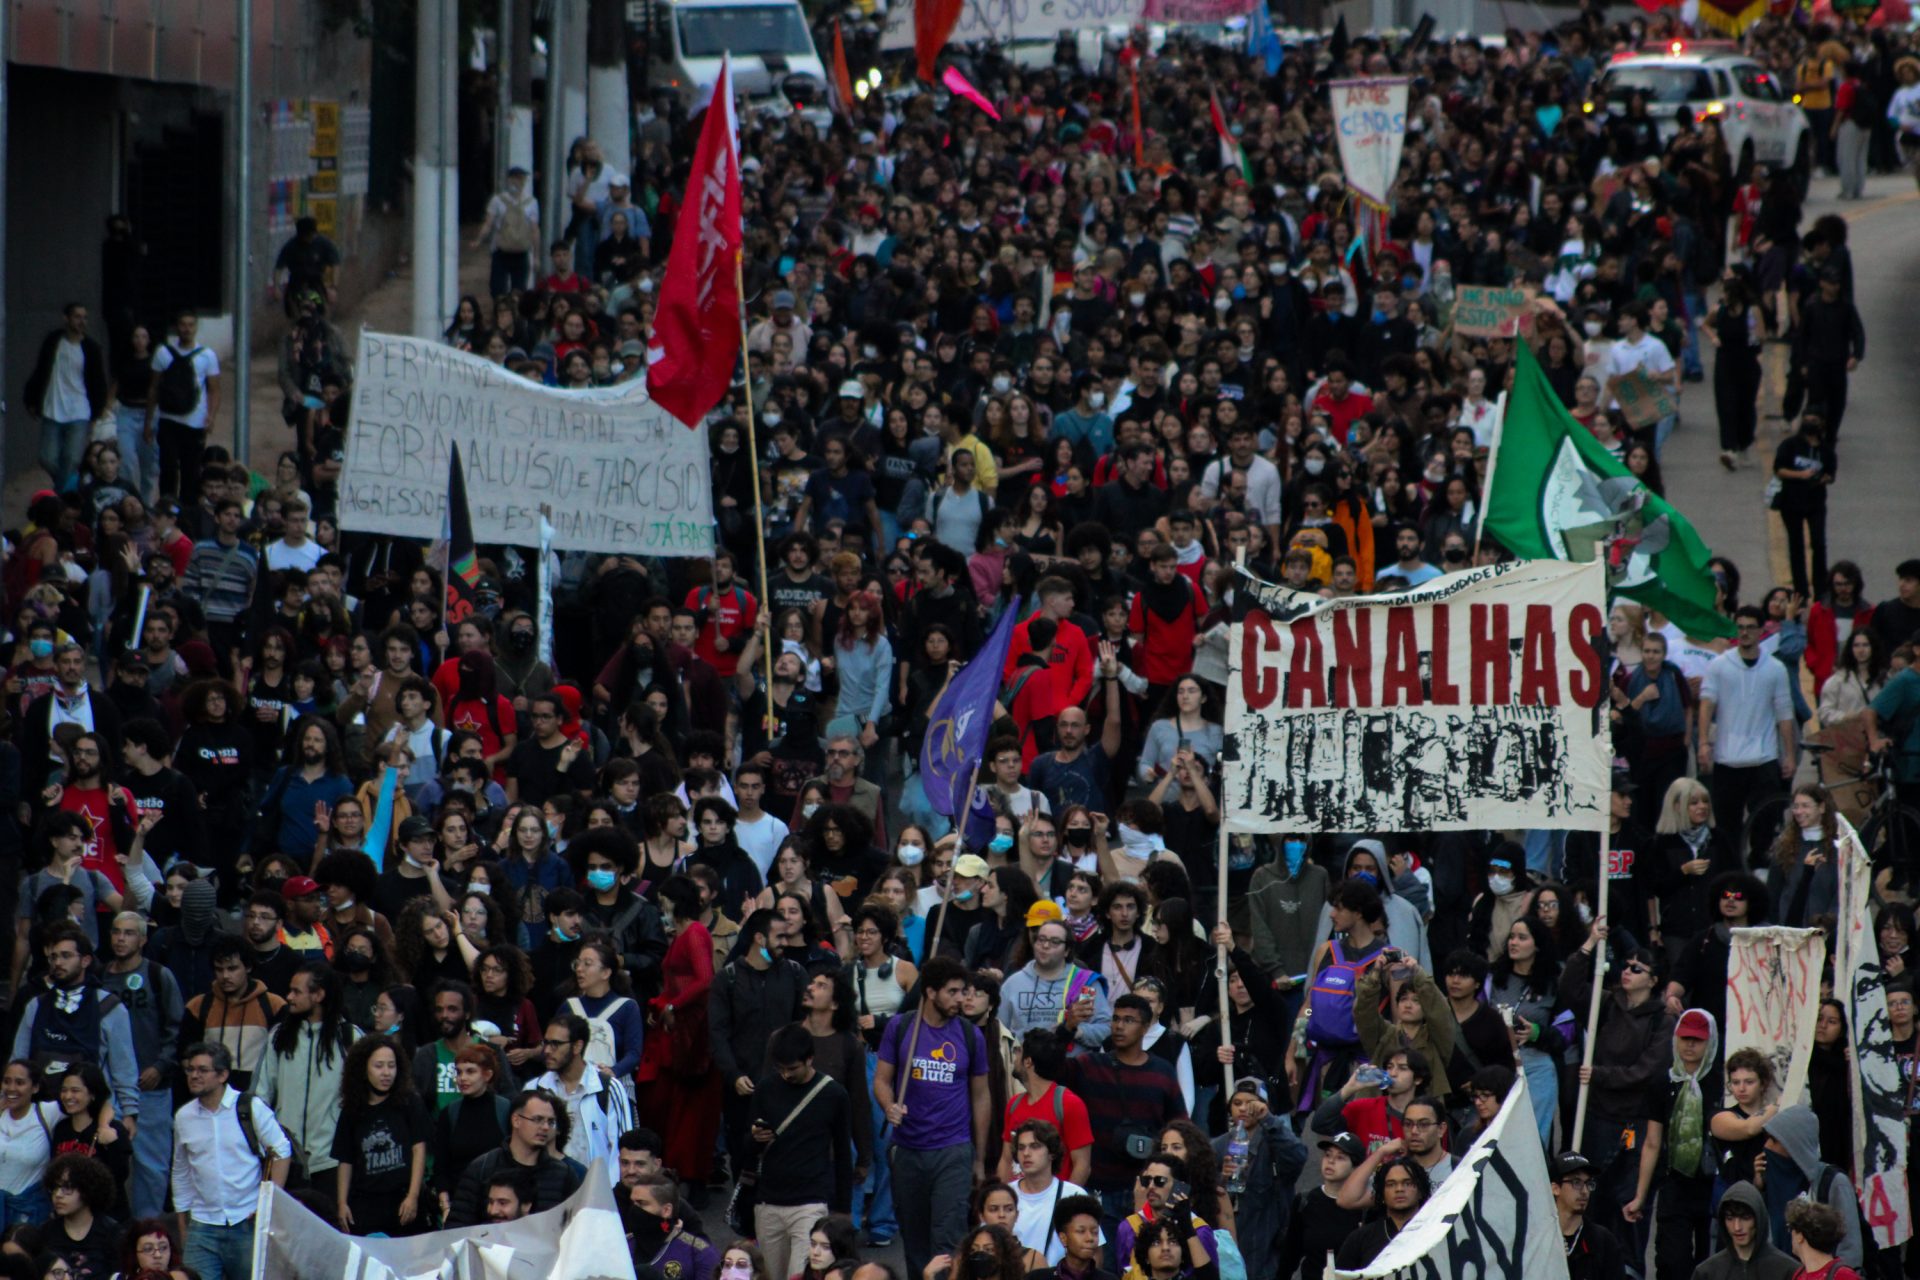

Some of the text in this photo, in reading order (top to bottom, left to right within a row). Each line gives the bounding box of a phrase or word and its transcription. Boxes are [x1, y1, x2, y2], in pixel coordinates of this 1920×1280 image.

[382, 384, 498, 438] ISONOMIA
[595, 452, 700, 512] TARCÍSIO
[1412, 568, 1491, 604] UNIVERSIDADE
[1242, 603, 1604, 710] CANALHAS
[1608, 850, 1635, 874] SP
[912, 1057, 956, 1073] vamos
